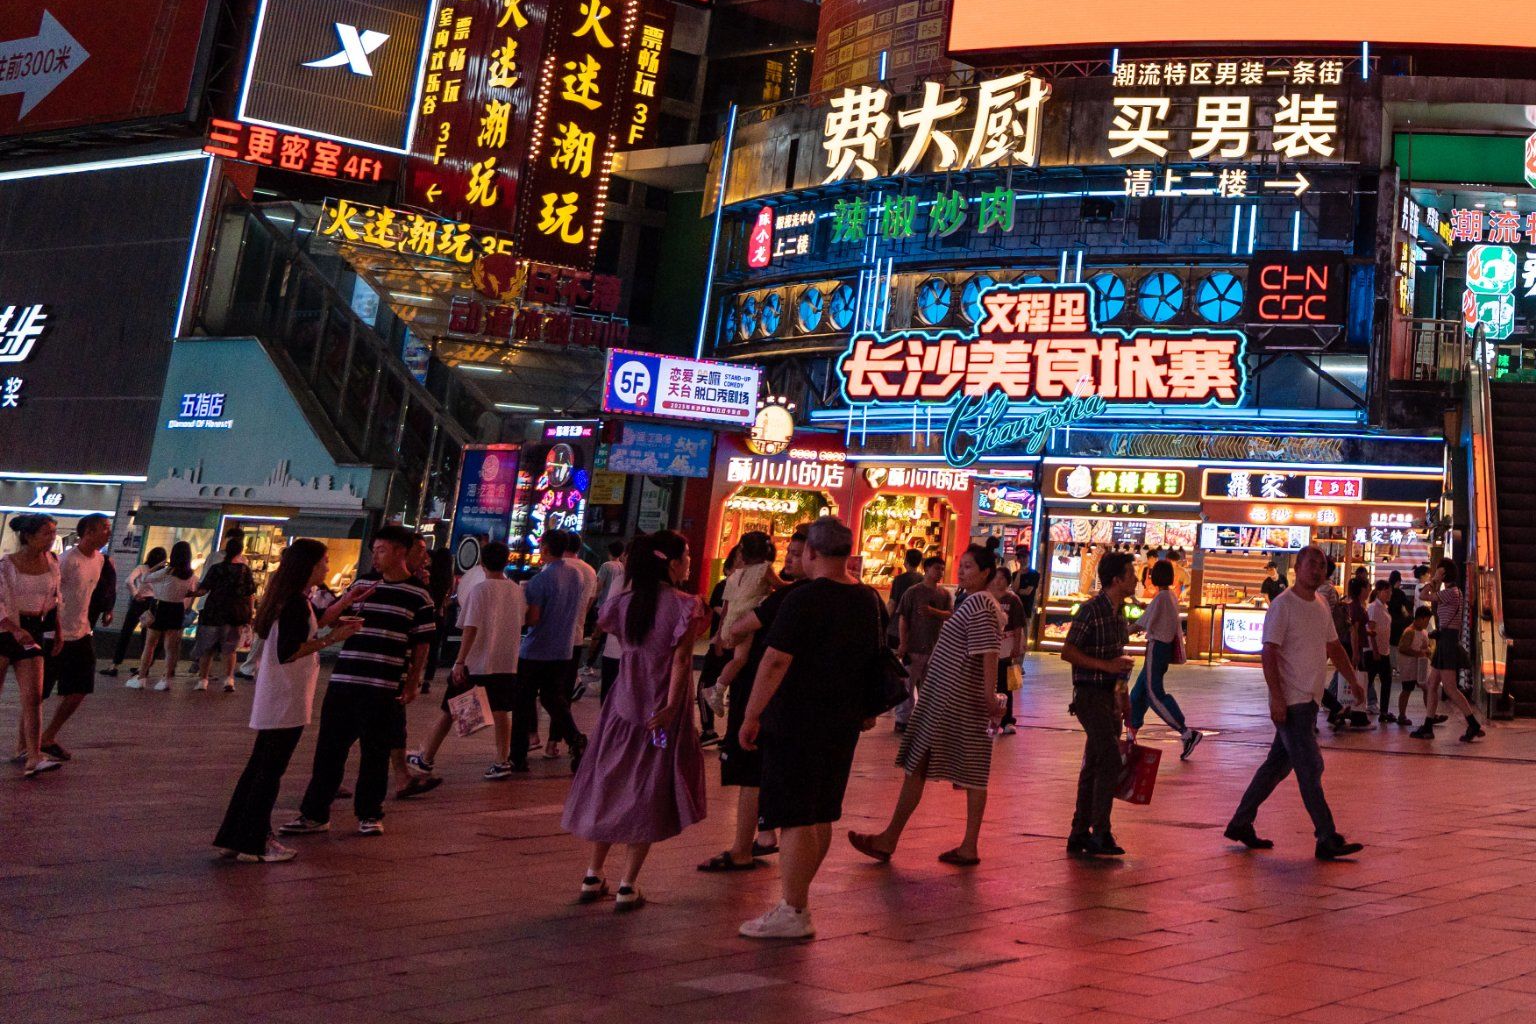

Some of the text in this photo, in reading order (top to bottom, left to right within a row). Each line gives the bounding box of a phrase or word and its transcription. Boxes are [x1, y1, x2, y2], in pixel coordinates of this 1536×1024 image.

[421, 7, 455, 116] 室内欢乐谷
[1112, 61, 1343, 87] 潮流特区男装一条街
[433, 122, 450, 166] 3F
[627, 103, 648, 145] 3F
[821, 70, 1051, 184] 费大厨
[1108, 94, 1338, 158] 买男装
[204, 118, 371, 180] 三更密室 4F
[1123, 168, 1248, 199] 请上二楼
[325, 199, 474, 263] 火迷潮玩
[831, 186, 1018, 244] 辣椒炒肉
[772, 234, 809, 257] 上二楼
[981, 292, 1090, 334] 文程里
[620, 371, 645, 395] 5F
[669, 367, 694, 384] 恋爱
[842, 336, 1239, 402] 长沙美食城寨
[180, 393, 226, 417] 五指店
[668, 382, 692, 398] 天台
[694, 386, 750, 405] 脱口秀剧场
[942, 373, 1109, 469] Changsha
